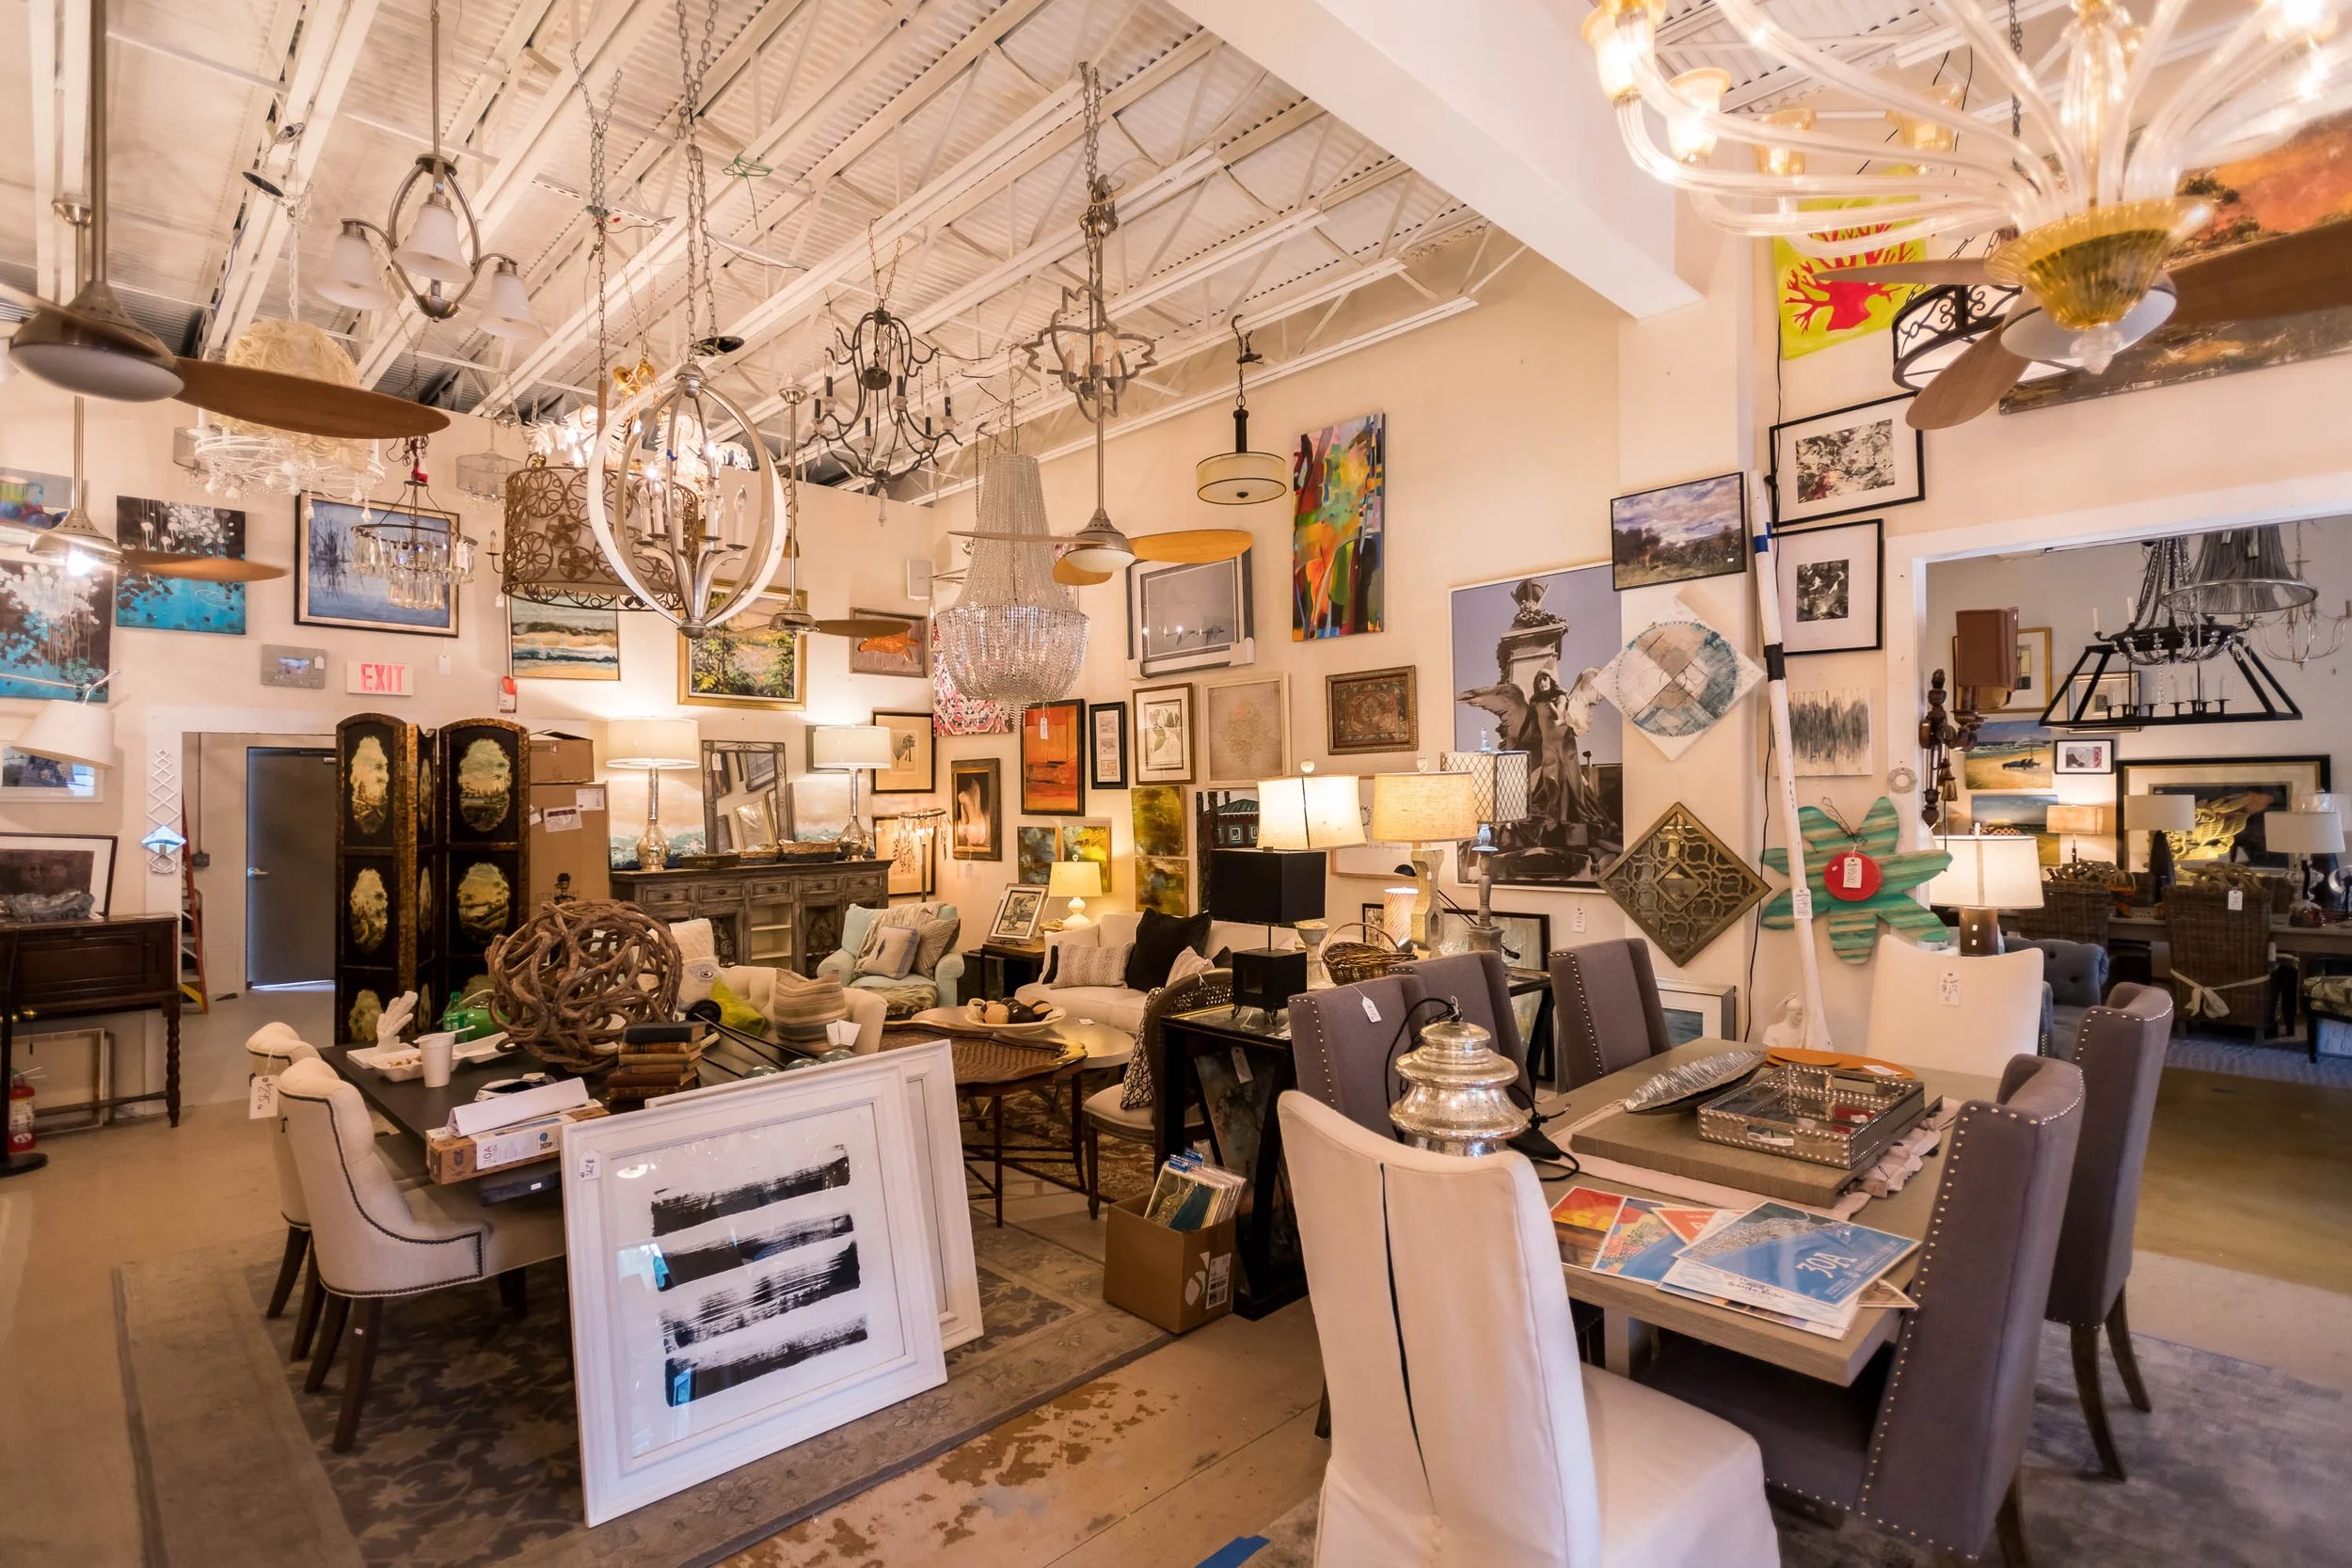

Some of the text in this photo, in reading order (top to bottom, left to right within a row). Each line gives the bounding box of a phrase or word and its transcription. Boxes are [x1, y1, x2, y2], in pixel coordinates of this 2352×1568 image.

[360, 663, 405, 692] EXIT
[483, 1144, 493, 1165] 30A
[1794, 1252, 1858, 1278] 30A
